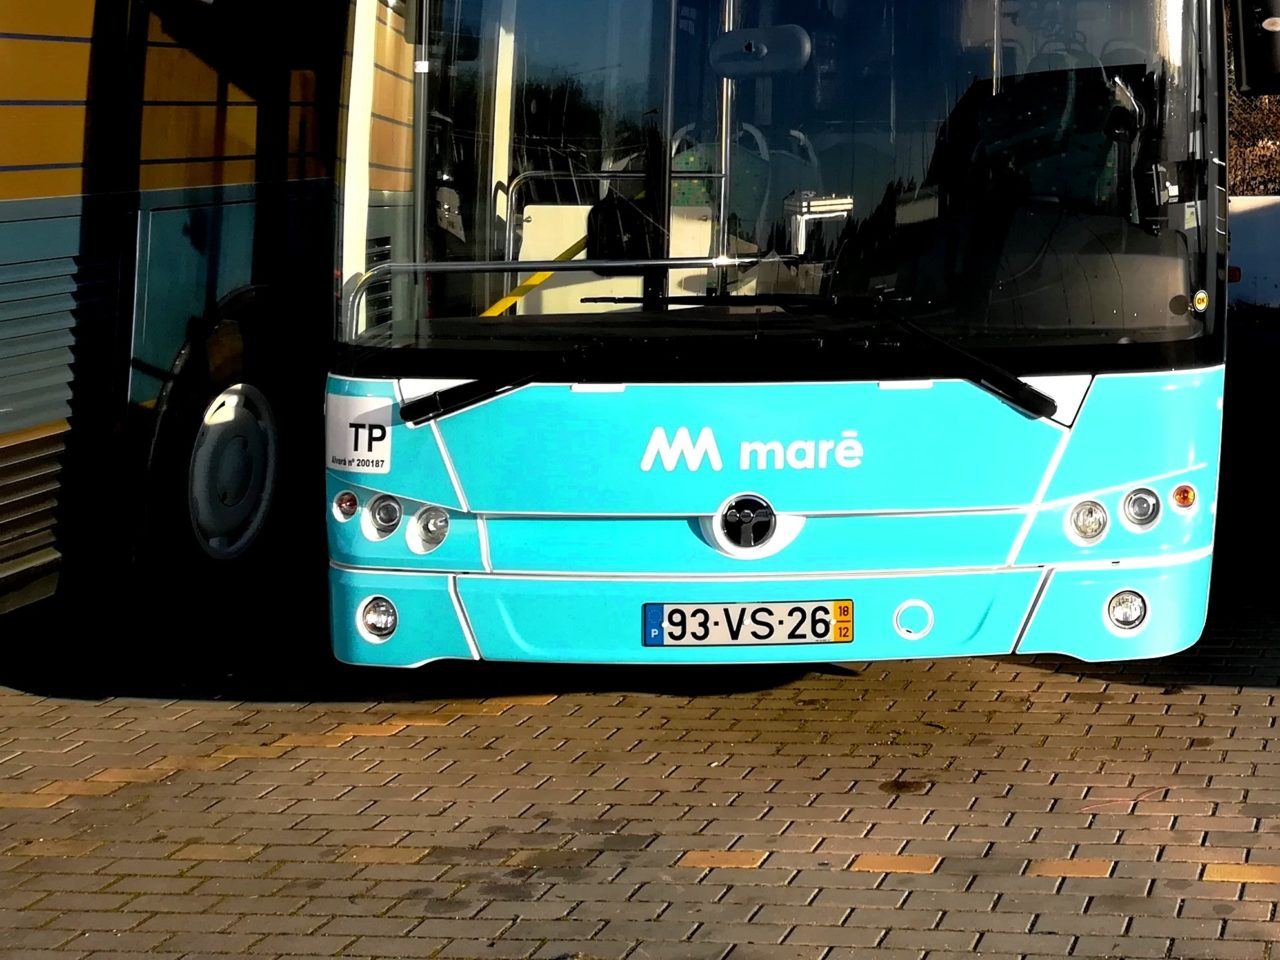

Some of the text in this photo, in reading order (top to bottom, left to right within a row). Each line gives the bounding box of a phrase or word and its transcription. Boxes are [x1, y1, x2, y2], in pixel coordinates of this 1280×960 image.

[349, 422, 386, 452] TP
[356, 458, 385, 468] 200187
[838, 605, 850, 616] 18
[651, 628, 658, 638] P
[838, 626, 850, 638] 12
